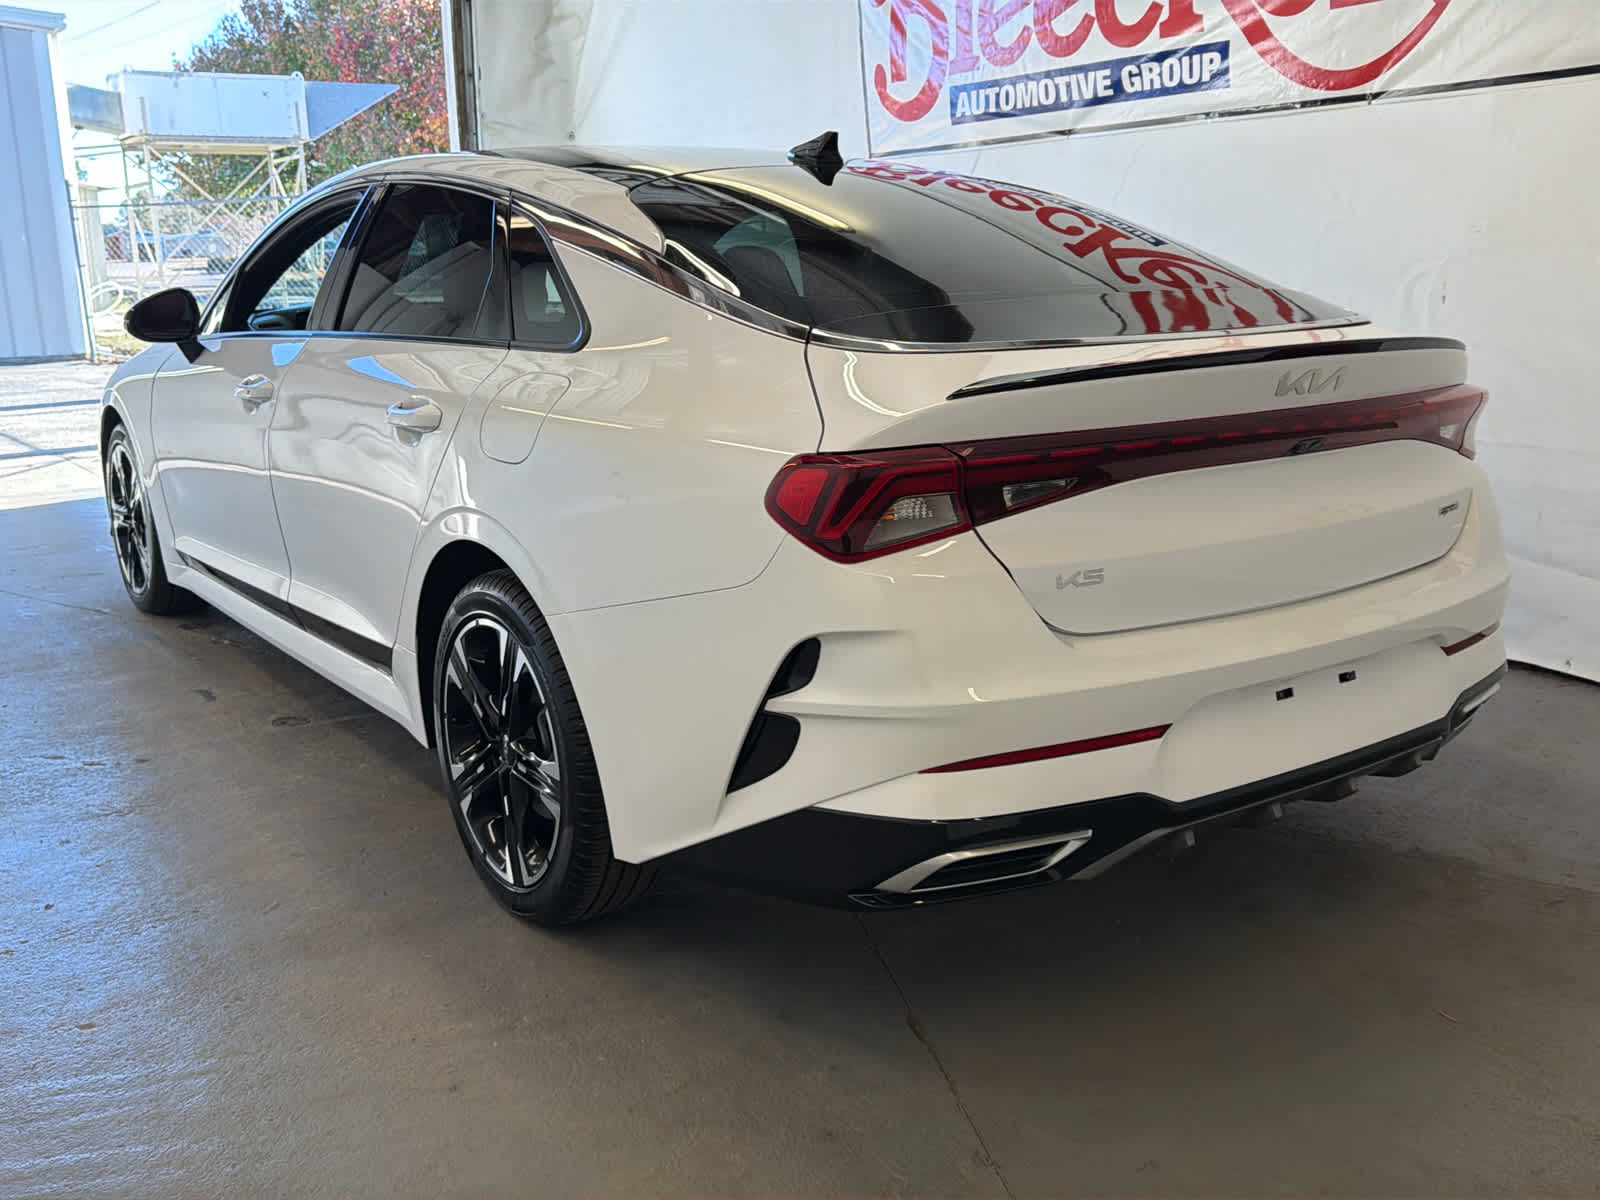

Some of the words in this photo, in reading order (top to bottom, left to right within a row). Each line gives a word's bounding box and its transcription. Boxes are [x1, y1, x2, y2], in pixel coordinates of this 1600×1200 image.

[955, 69, 1114, 118] AUTOMOTIVE
[1120, 51, 1222, 101] GROUP
[1055, 567, 1105, 589] K5
